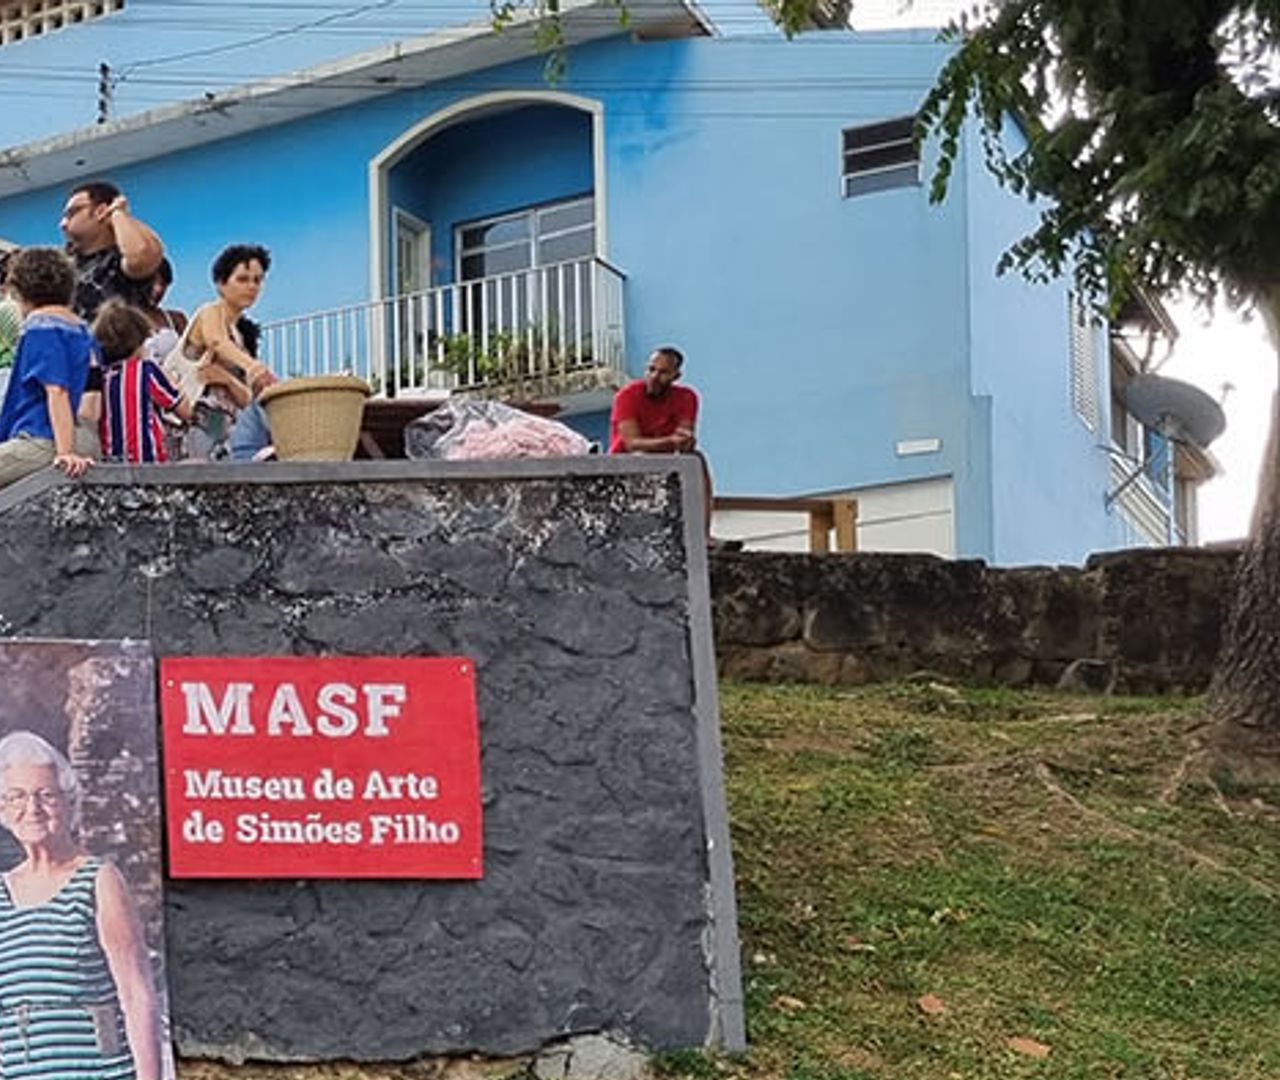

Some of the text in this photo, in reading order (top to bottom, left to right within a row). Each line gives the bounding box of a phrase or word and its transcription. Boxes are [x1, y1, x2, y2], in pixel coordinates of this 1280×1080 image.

[181, 682, 407, 737] MASF
[183, 768, 439, 800] Museu de Arte
[182, 810, 460, 845] de Simões Filho
